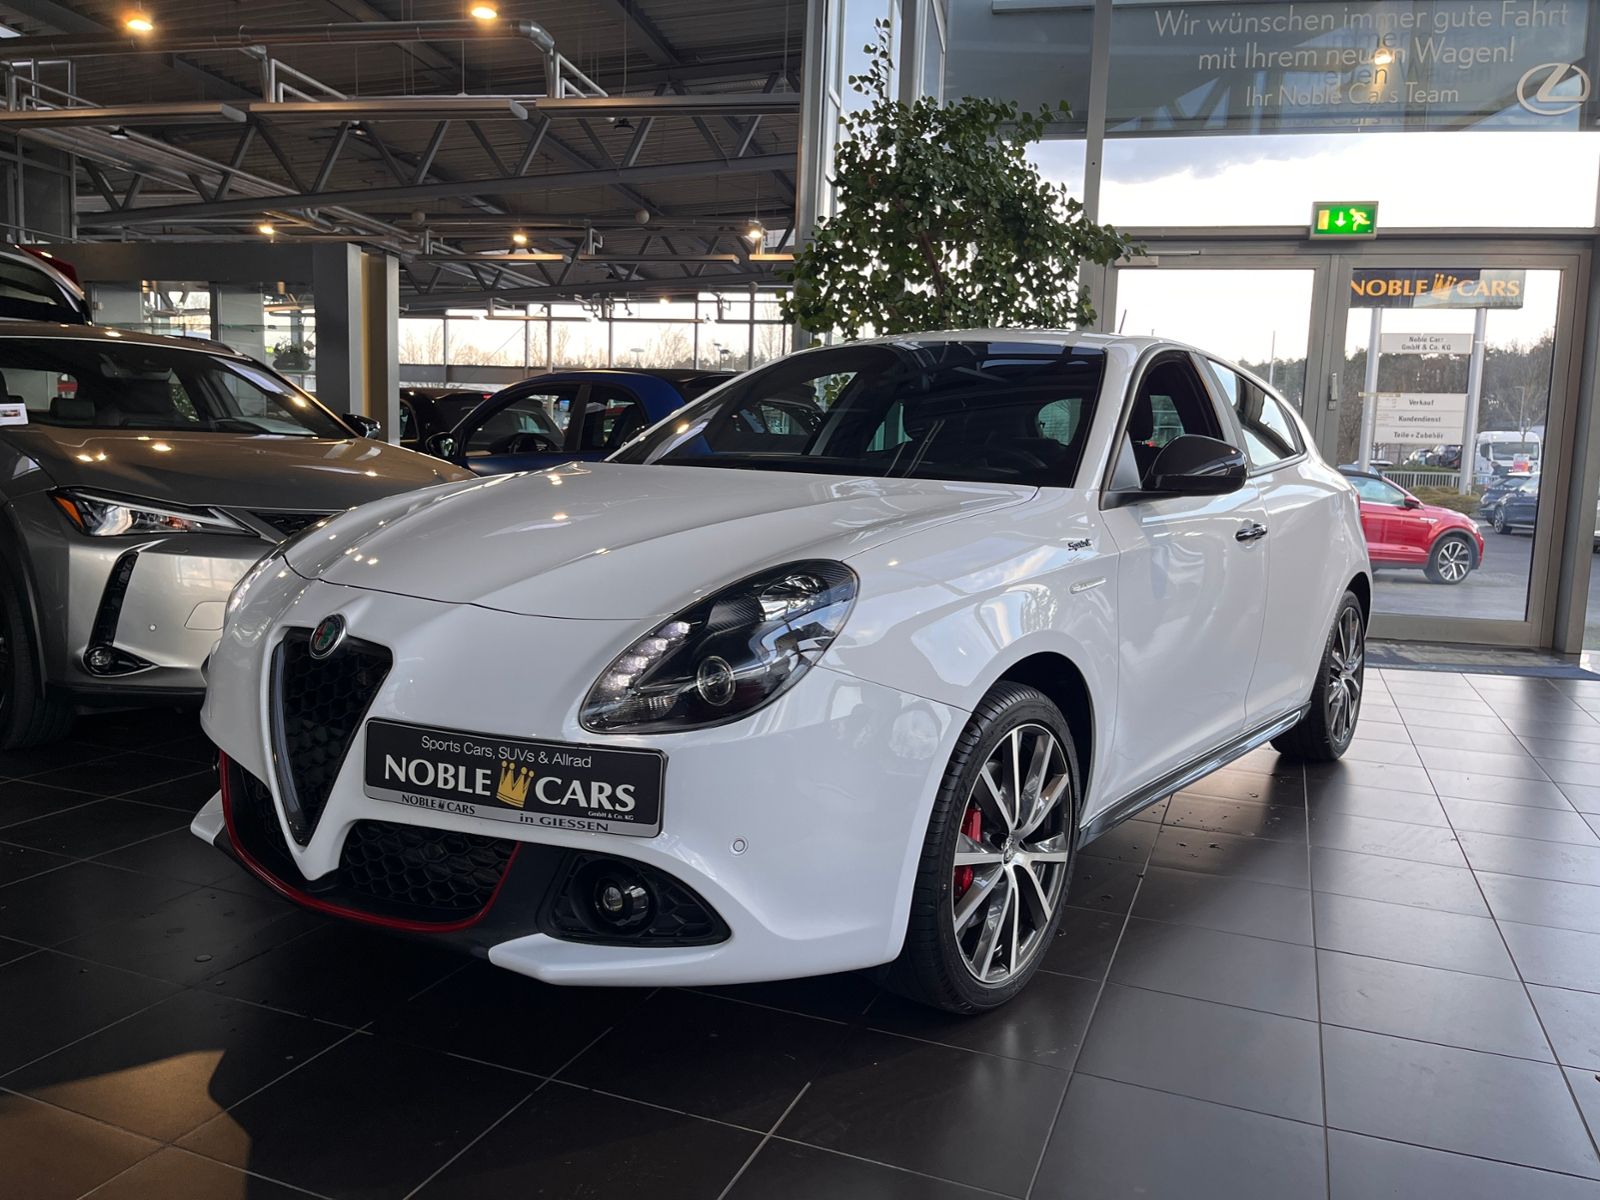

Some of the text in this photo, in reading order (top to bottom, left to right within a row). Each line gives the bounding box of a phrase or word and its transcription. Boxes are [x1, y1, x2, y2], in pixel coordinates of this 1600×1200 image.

[1155, 0, 1568, 36] Wir wünschen immer gute Fahrt
[1198, 47, 1237, 70] mit
[1244, 42, 1318, 68] Ihrem
[1326, 46, 1406, 66] neuen
[1415, 35, 1516, 69] Wagen!
[1246, 81, 1459, 107] Ihr Noble Cas Team
[1350, 279, 1520, 297] NOBLE CARS
[1398, 415, 1442, 423] Kundendienst
[421, 735, 592, 768] Sports Cars, SUVs & Allrad
[385, 754, 636, 812] NOBLE CARS
[401, 794, 609, 832] NOBLE CARS in GIESSEN
[587, 810, 607, 818] GmbH
